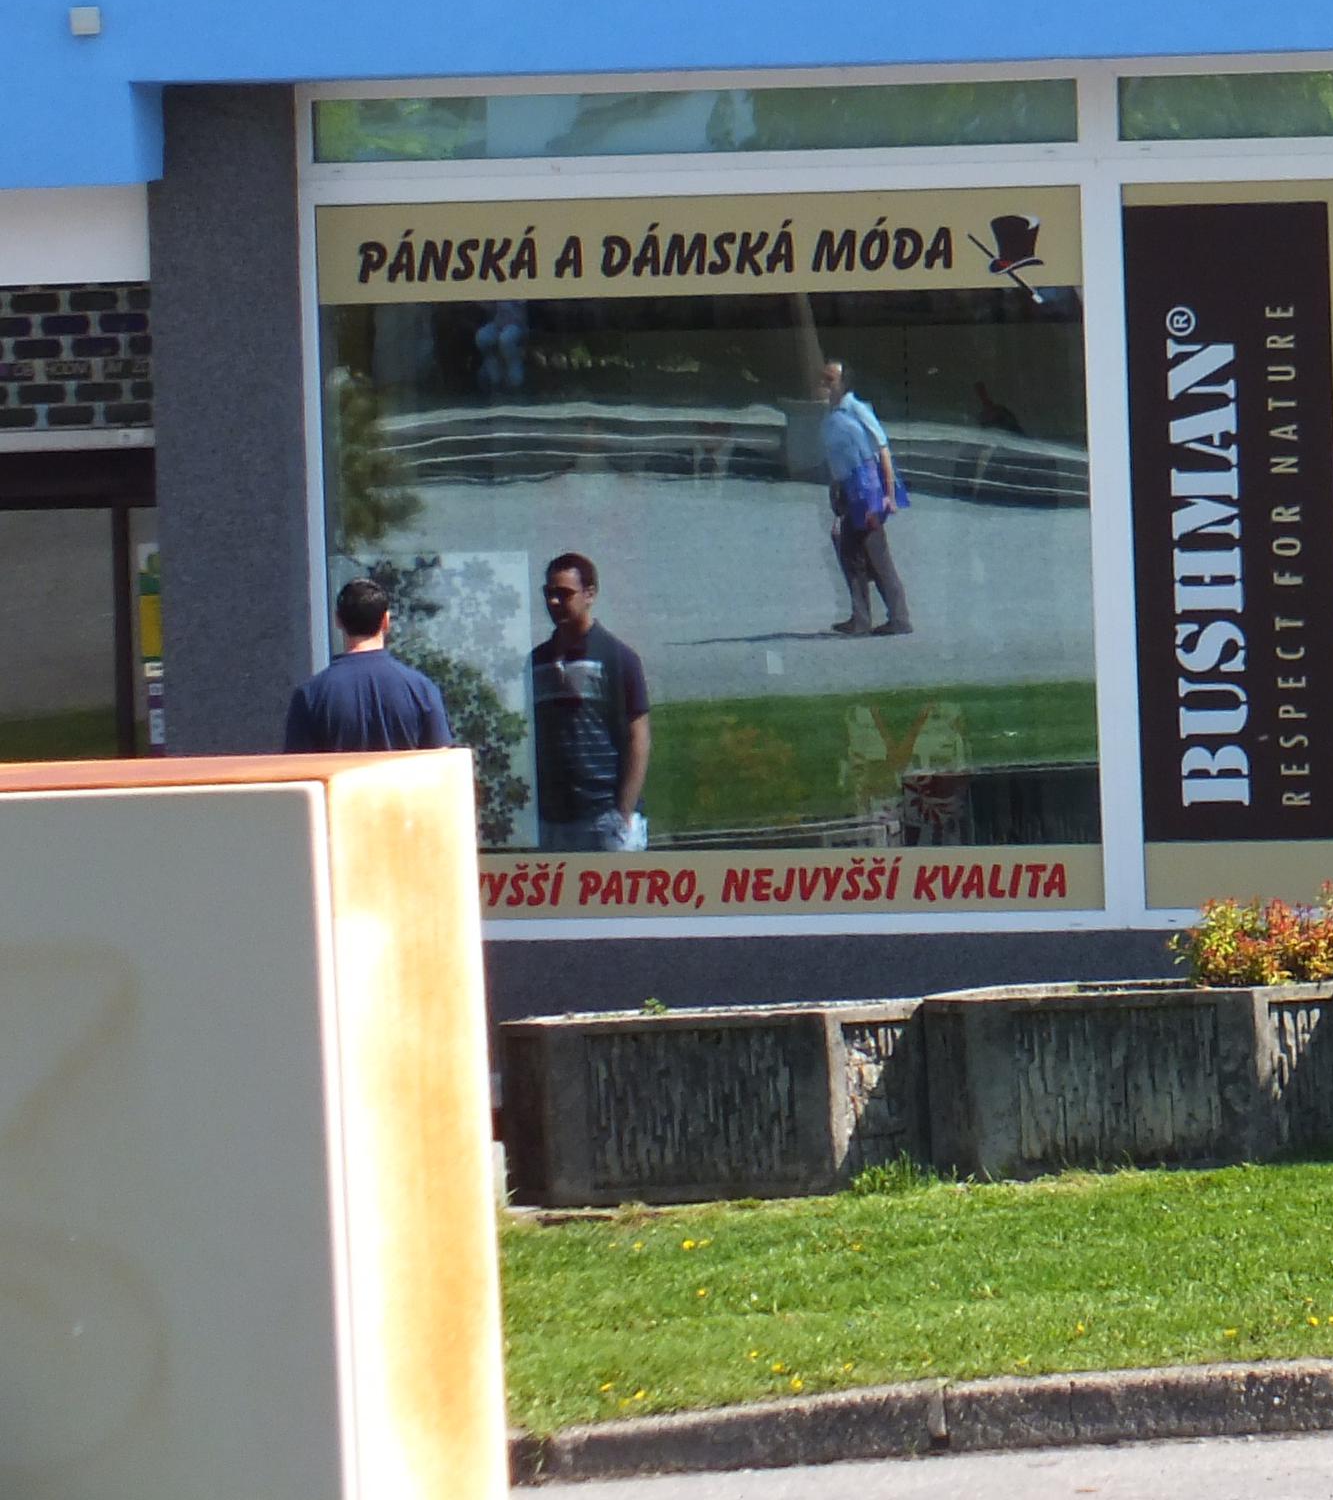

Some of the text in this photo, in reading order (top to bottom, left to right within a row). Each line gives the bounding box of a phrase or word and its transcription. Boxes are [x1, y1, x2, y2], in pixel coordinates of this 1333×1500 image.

[358, 216, 953, 284] PÁNSKÁ A DÁMSKÁ MÓDA
[1264, 305, 1311, 807] RESPECT FOR NATURE
[578, 869, 705, 910] PATRO,
[721, 855, 903, 903] NEJVYŠŠÍ
[914, 863, 1068, 902] KVALITA
